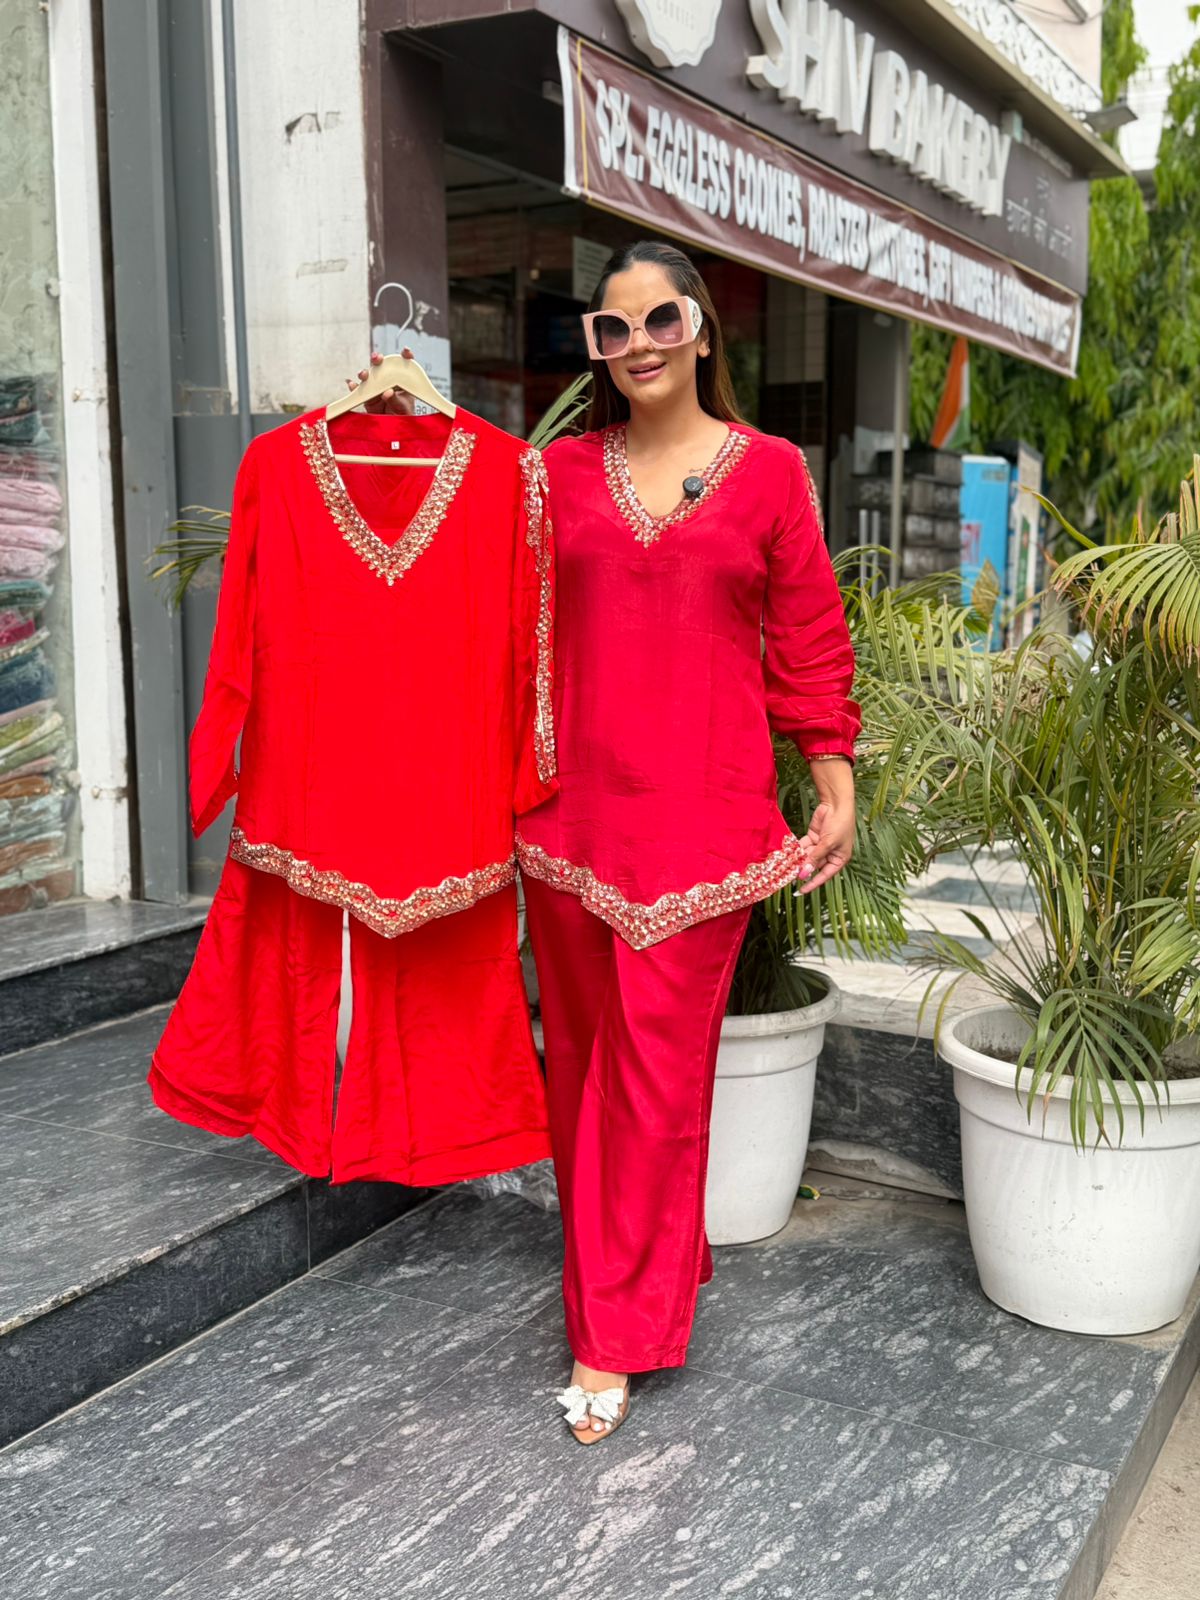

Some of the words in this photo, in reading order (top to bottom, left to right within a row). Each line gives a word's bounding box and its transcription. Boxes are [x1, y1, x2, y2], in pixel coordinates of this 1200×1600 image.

[645, 104, 731, 219] EGGLESS
[746, 0, 875, 135] SHIV
[869, 50, 1011, 217] BAKERY
